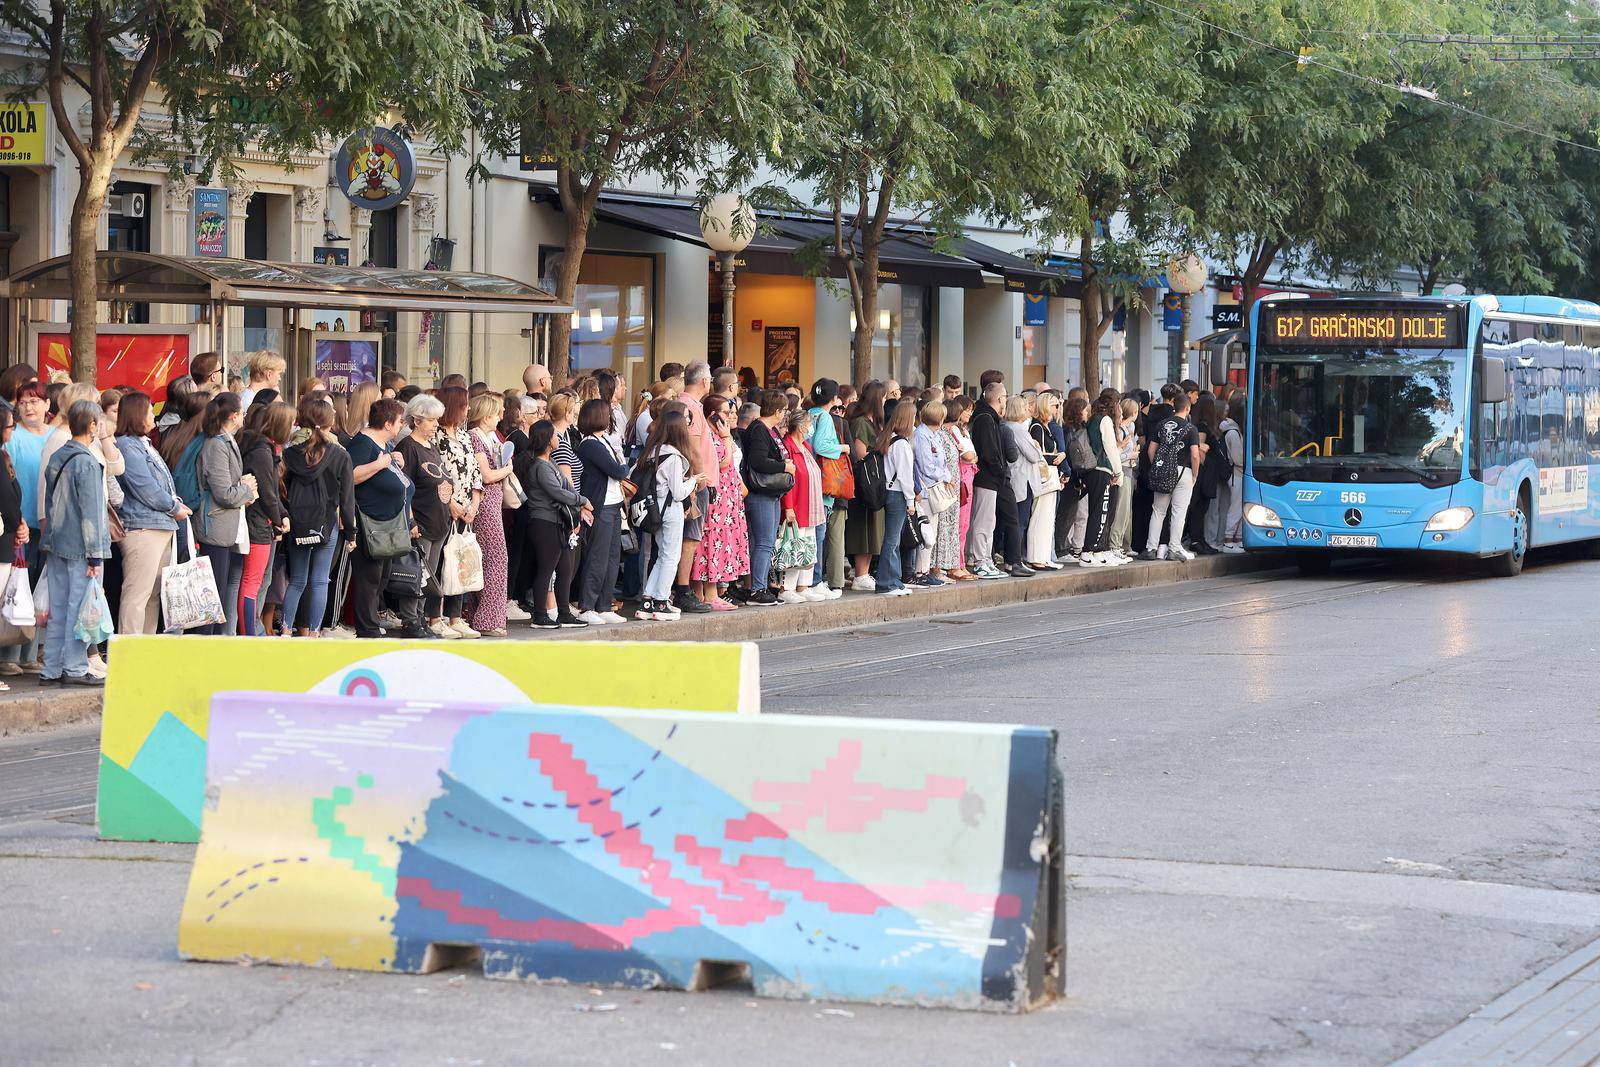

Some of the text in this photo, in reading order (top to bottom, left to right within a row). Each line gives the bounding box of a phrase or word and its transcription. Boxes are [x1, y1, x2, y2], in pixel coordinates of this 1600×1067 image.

[1217, 312, 1240, 322] S.M.
[1277, 313, 1446, 338] 617 GRAČANSKO DOLJE
[1296, 489, 1322, 501] ZET
[1340, 491, 1367, 504] 566
[295, 535, 321, 545] PUMA
[1332, 536, 1342, 546] ZG
